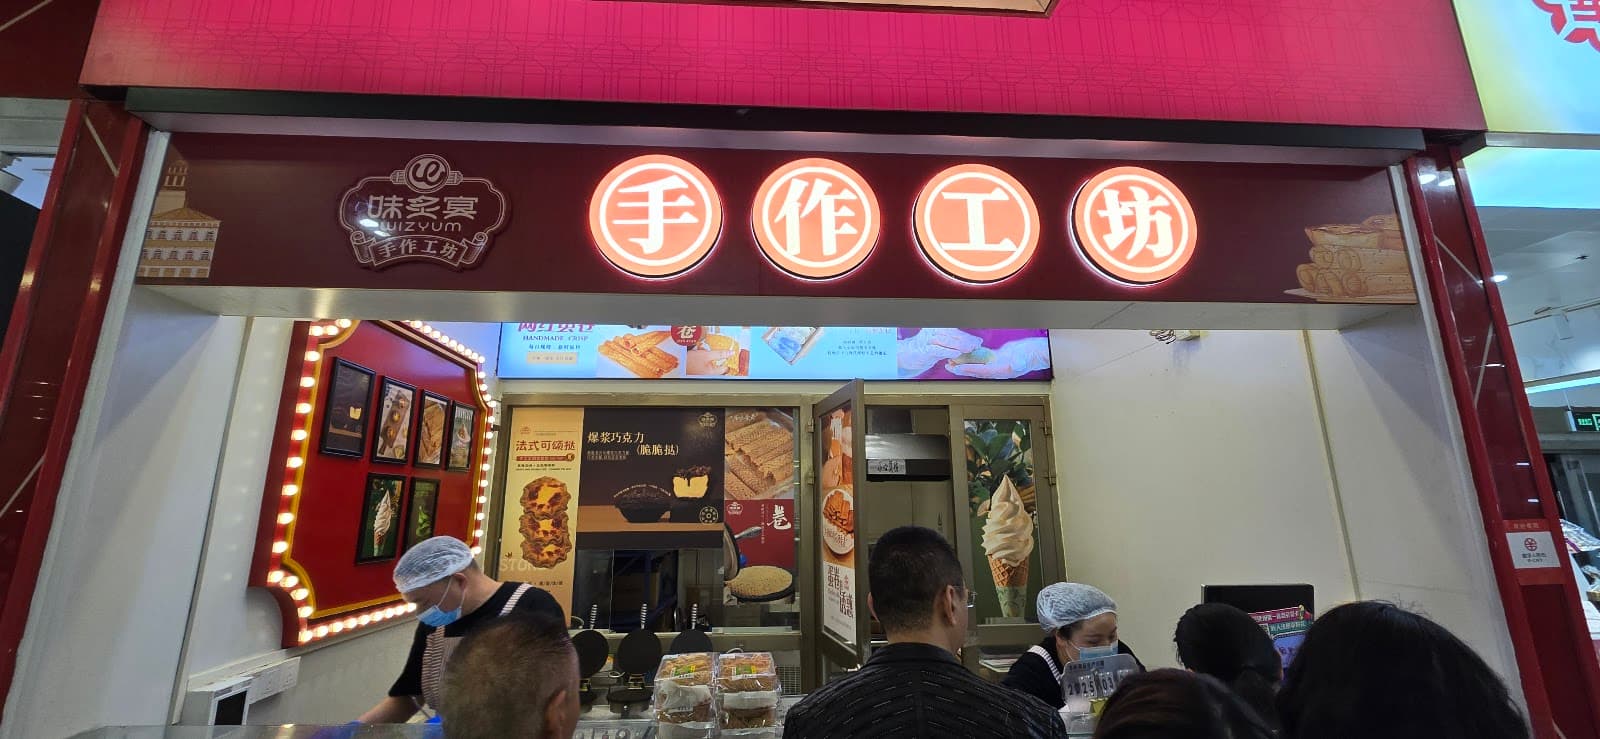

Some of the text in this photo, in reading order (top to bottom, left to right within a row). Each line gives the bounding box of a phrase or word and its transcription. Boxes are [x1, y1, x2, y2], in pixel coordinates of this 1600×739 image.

[367, 195, 479, 220] 味炙宴
[611, 174, 1175, 261] 手作工坊
[379, 239, 458, 259] 手作工坊
[515, 440, 576, 452] 法式可颂挞
[587, 431, 645, 444] 爆浆巧克力
[766, 504, 792, 530] 卷
